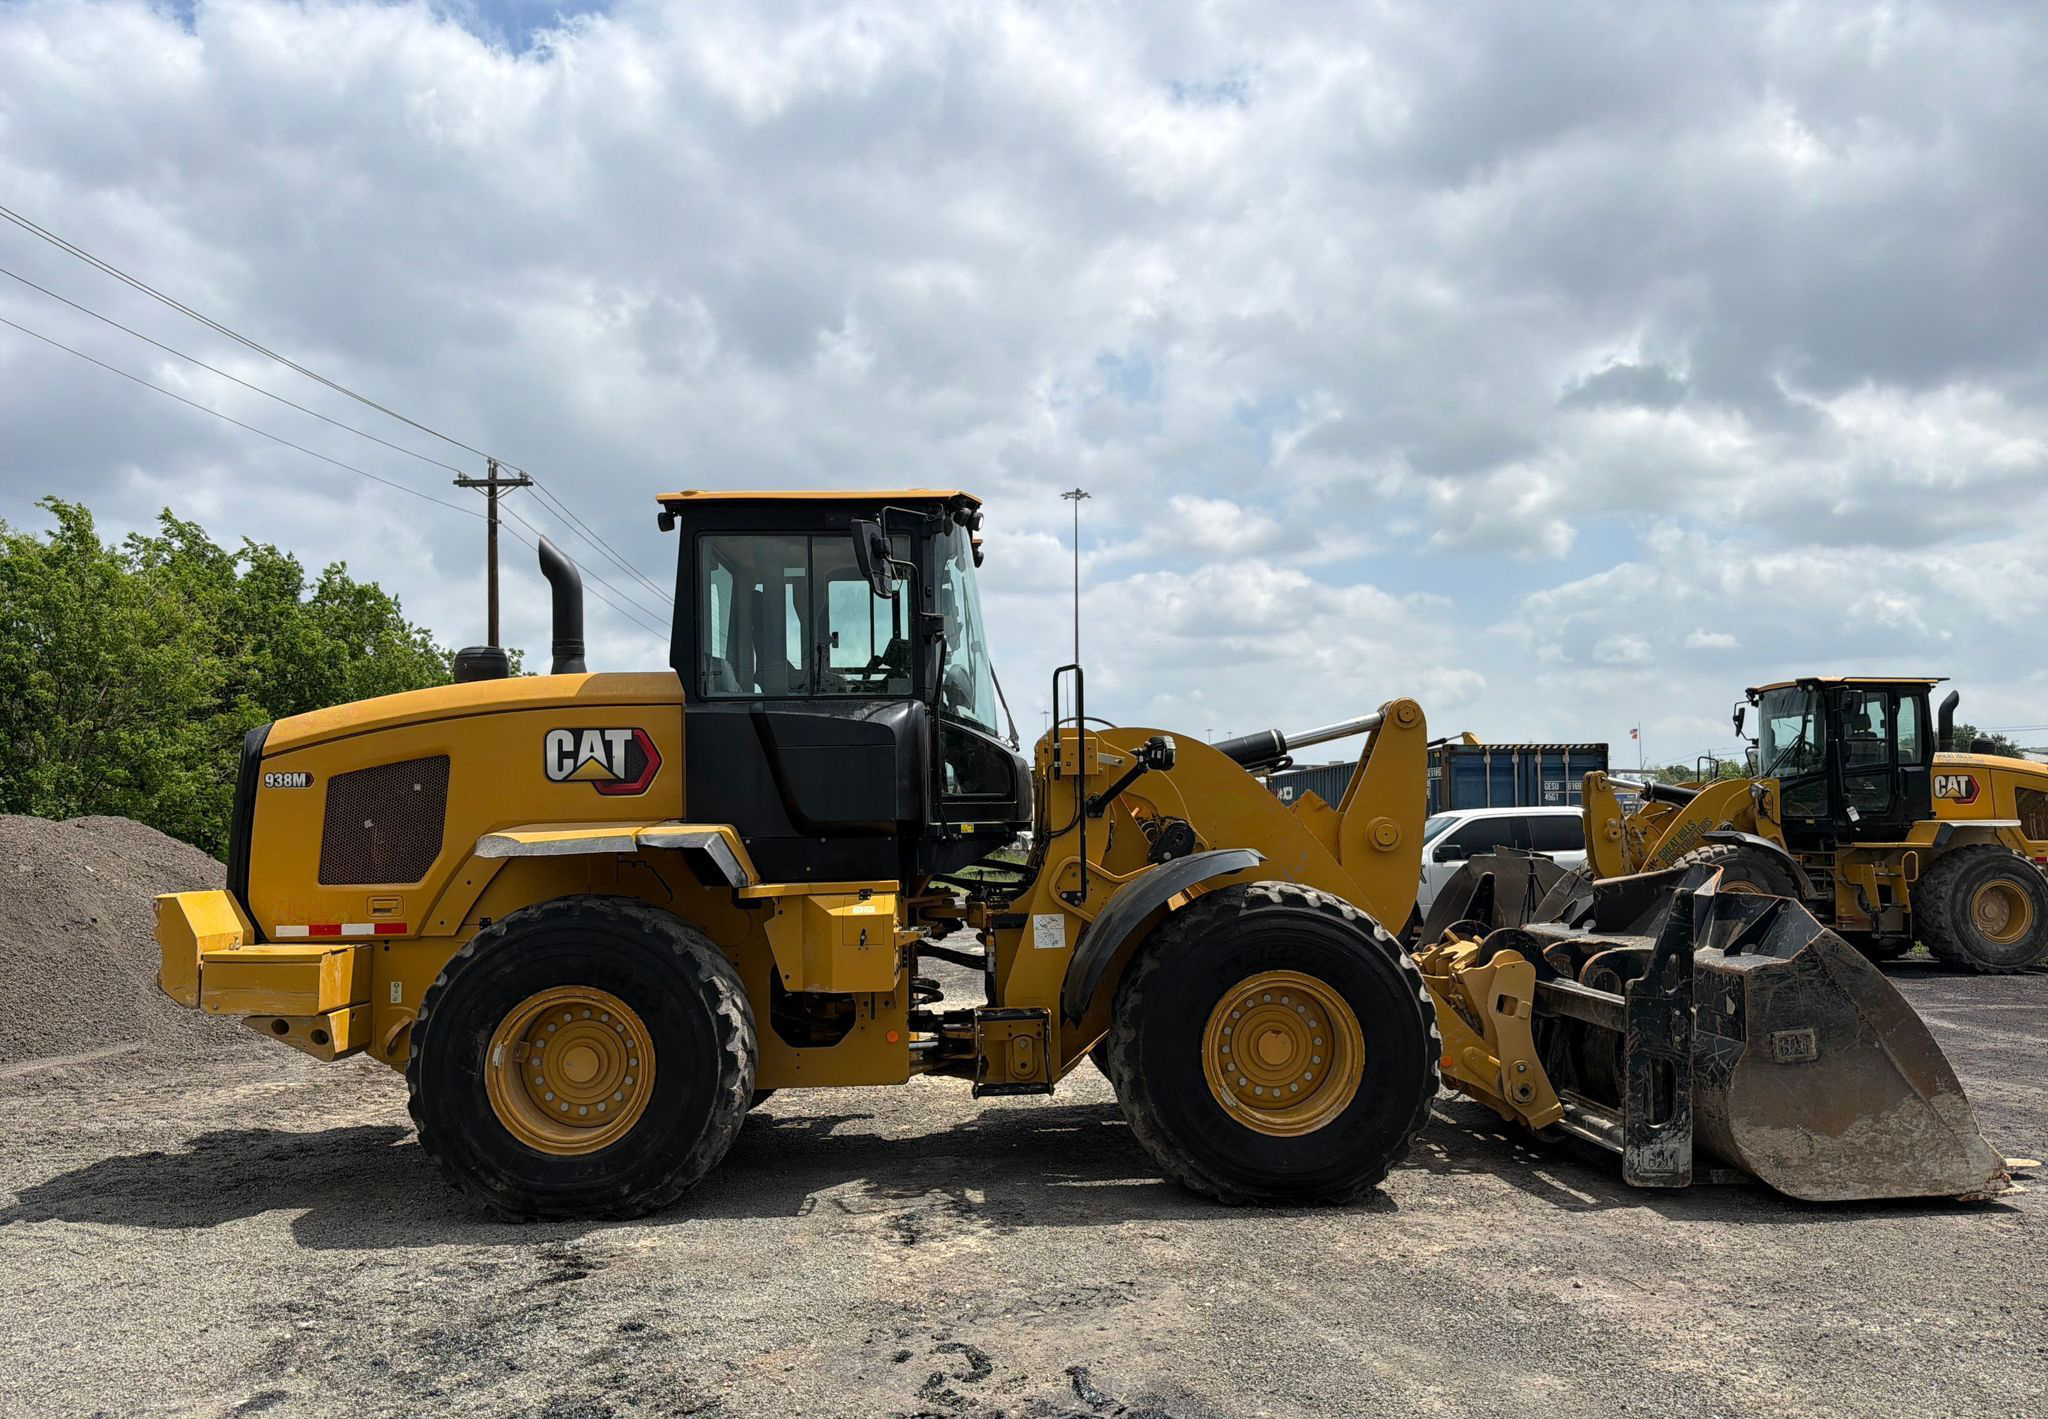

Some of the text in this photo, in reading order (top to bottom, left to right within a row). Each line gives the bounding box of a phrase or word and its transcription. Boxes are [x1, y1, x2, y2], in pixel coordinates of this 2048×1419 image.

[546, 729, 632, 780] CAT
[265, 773, 306, 788] 938M
[1544, 782, 1560, 791] GESU
[1935, 775, 1968, 797] CAT
[1544, 792, 1559, 801] 45G1
[1658, 820, 1696, 861] GREAT HILLS
